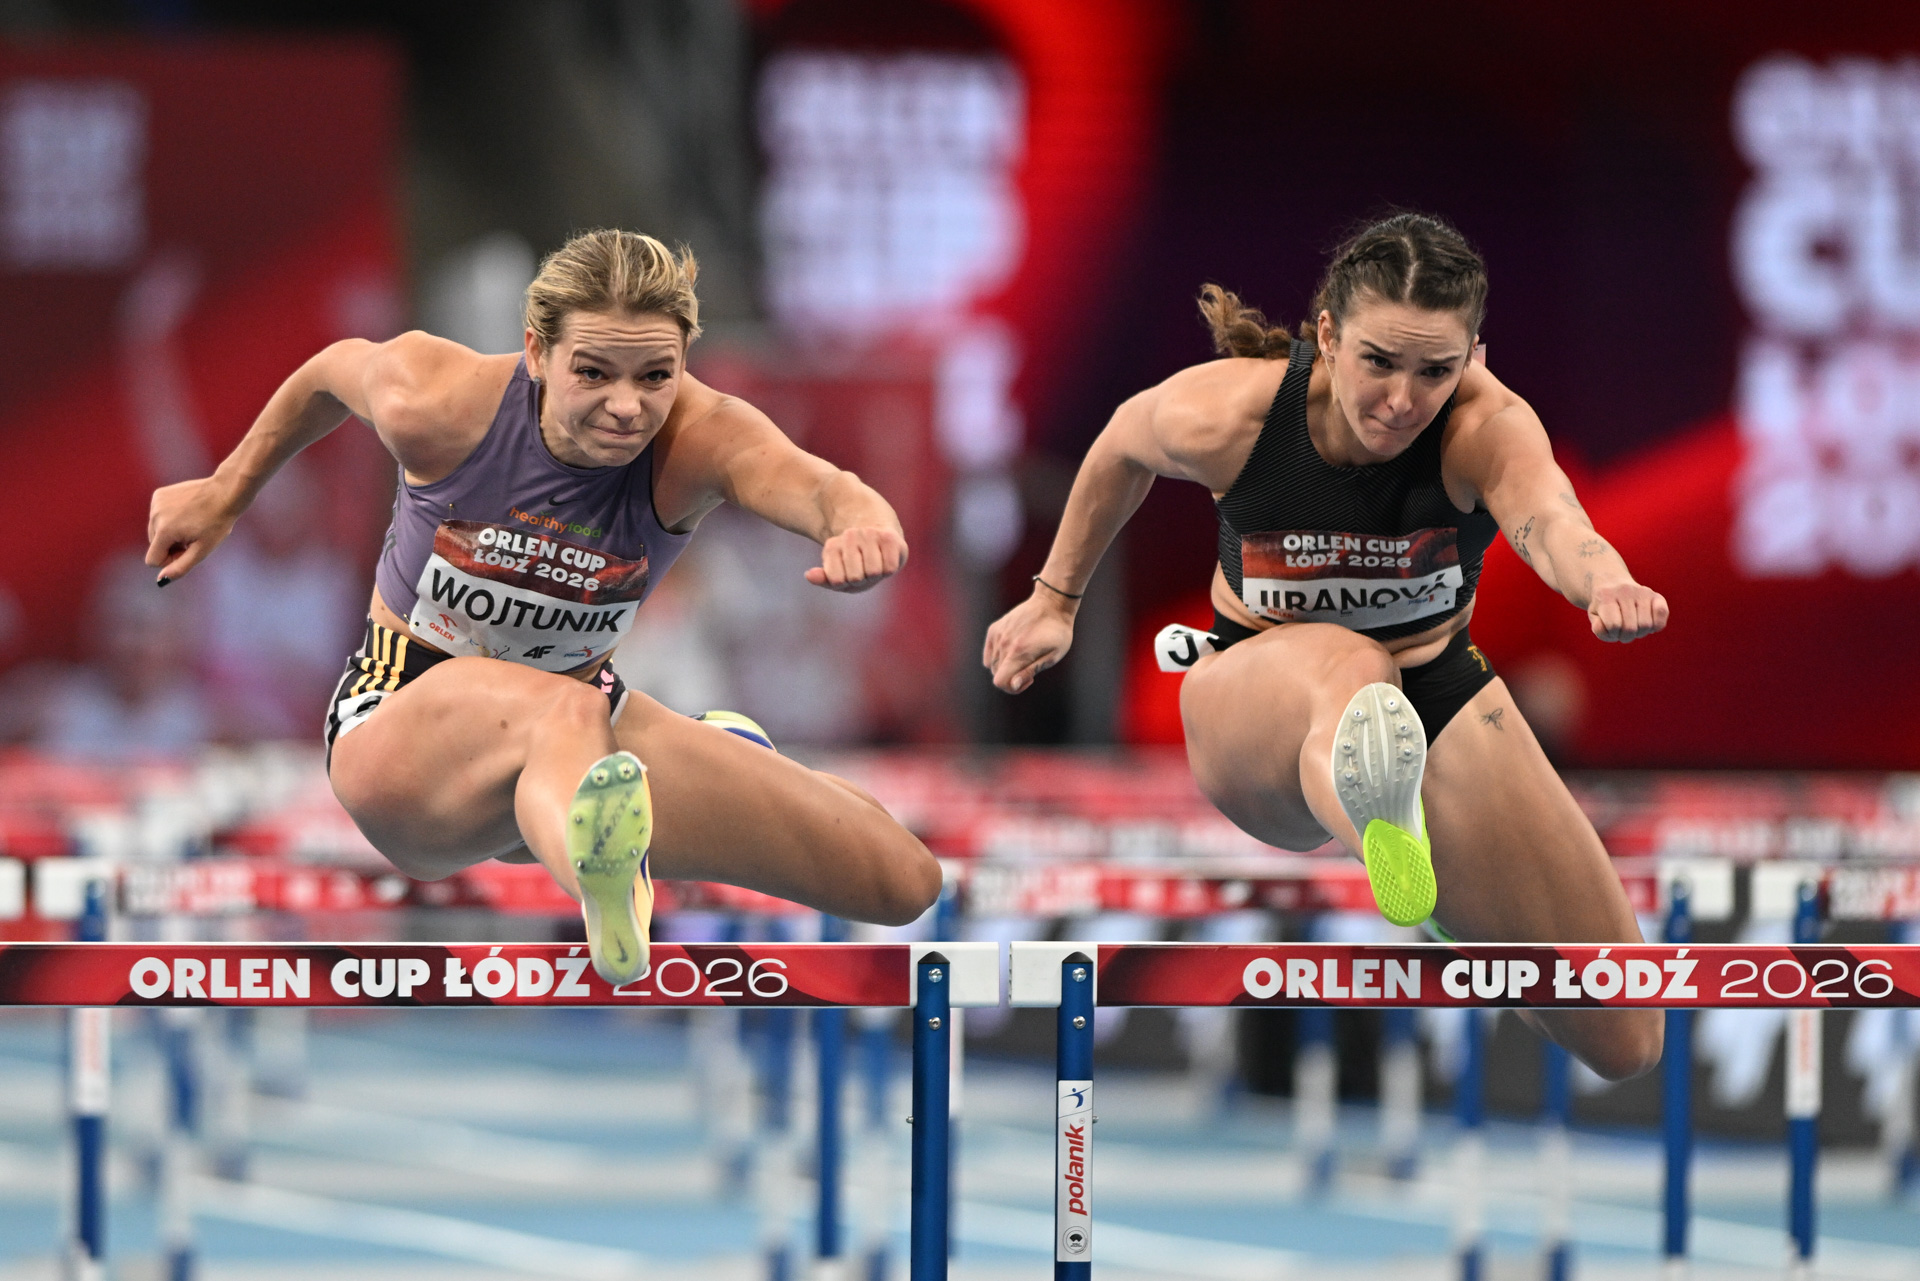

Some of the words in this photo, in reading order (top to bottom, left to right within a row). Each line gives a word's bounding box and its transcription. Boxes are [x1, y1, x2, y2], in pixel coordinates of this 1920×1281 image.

[478, 527, 557, 560] ORLEN
[560, 546, 607, 573] CUP
[1282, 534, 1361, 552] ORLEN
[1365, 539, 1411, 555] CUP
[1285, 550, 1341, 568] ŁÓDŹ
[1347, 555, 1412, 569] 2026
[473, 546, 532, 574] ŁÓDŹ
[534, 562, 601, 593] 2026
[431, 567, 627, 633] WOJTUNIK
[1266, 608, 1295, 619] ORLEN
[428, 621, 456, 642] ORLEN
[129, 956, 311, 999] ORLEN
[330, 957, 430, 999] CUP
[443, 946, 591, 999] ŁÓDŹ
[1242, 957, 1421, 999] ORLEN
[1441, 958, 1540, 999] CUP
[1552, 947, 1699, 1000] ŁÓDŹ
[1720, 959, 1894, 999] 2026
[1064, 1123, 1088, 1217] polanik
